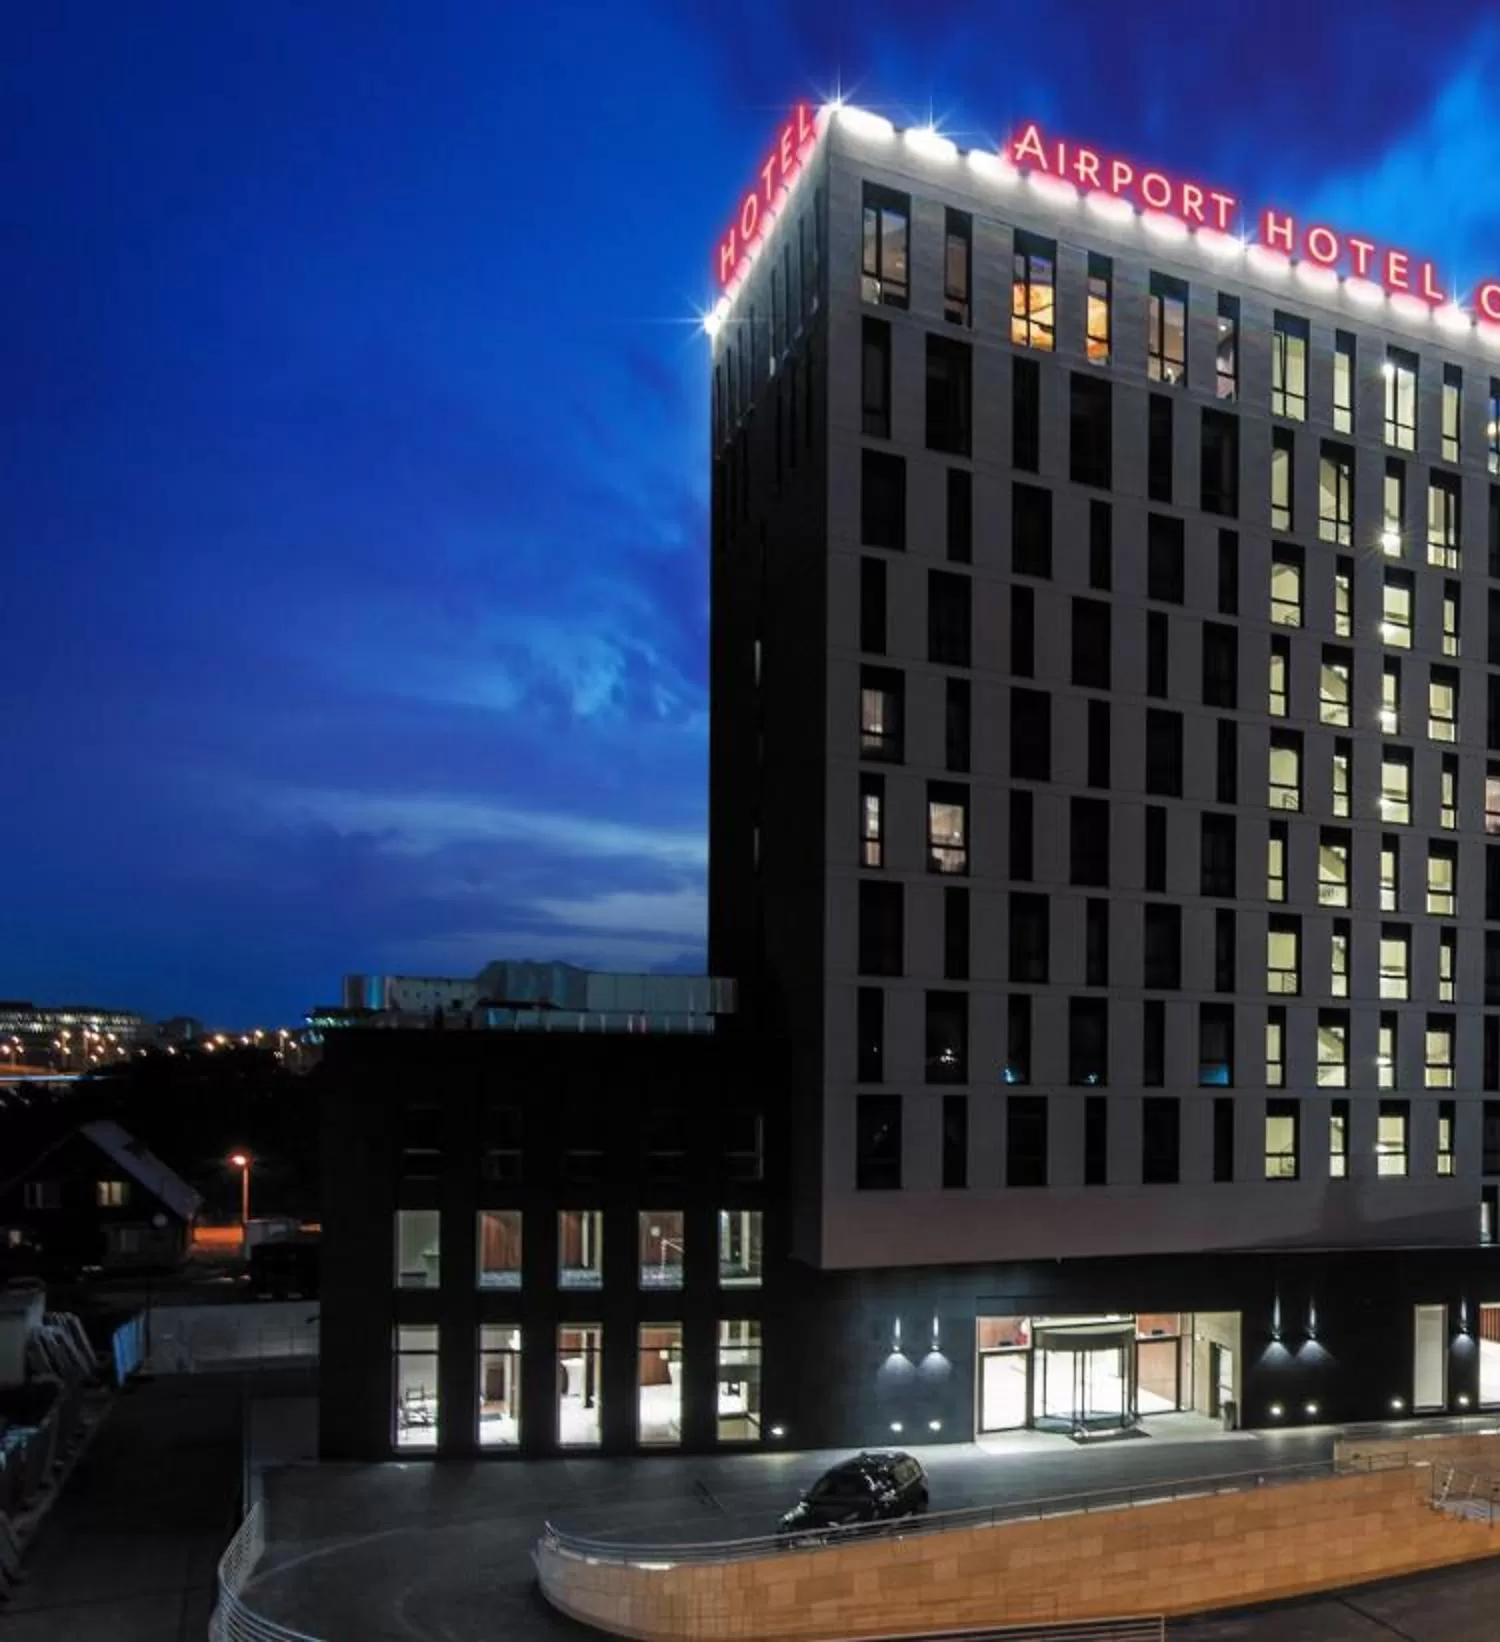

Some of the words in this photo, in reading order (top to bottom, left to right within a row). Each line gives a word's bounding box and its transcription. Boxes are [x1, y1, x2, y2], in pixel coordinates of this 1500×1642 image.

[720, 104, 811, 282] HOTEL
[1016, 126, 1233, 227] AIRPORT
[1267, 211, 1443, 299] HOTEL
